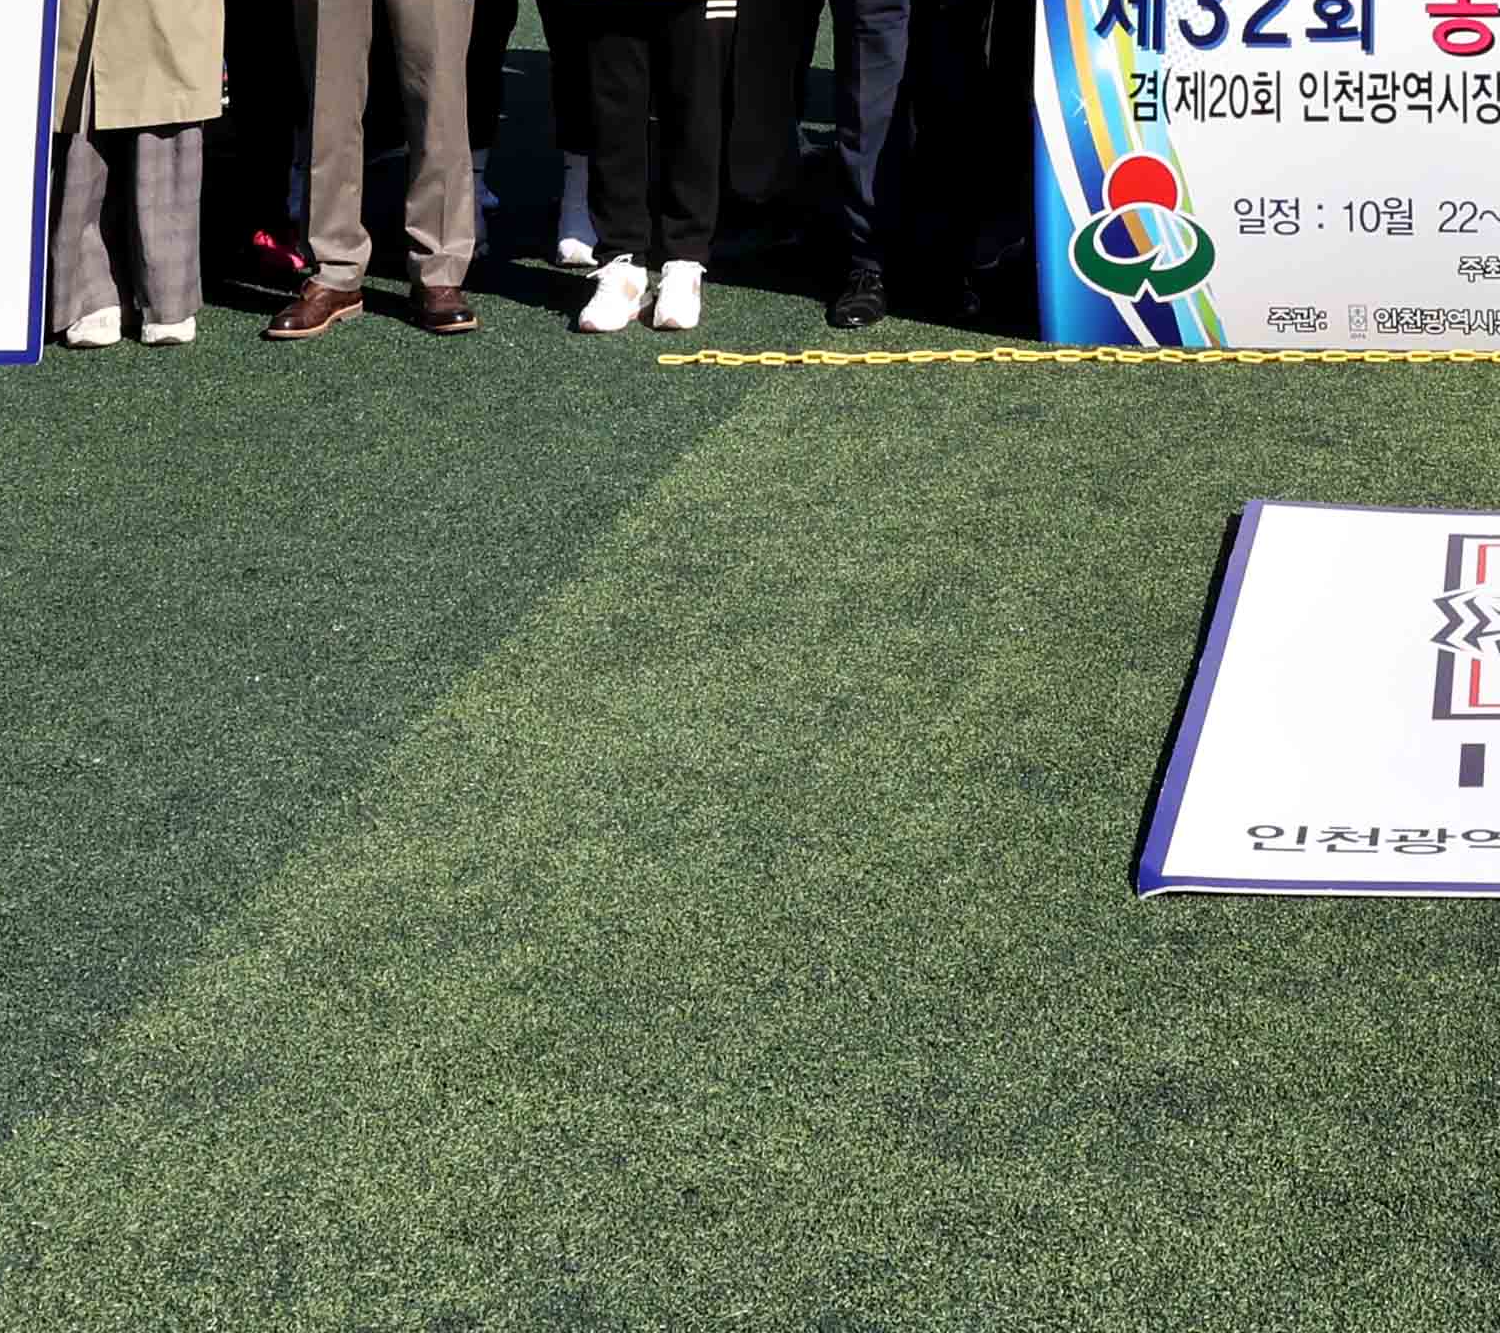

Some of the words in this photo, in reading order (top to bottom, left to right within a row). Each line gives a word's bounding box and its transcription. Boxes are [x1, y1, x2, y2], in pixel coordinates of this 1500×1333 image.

[1129, 70, 1282, 125] 겸(제20회
[1233, 196, 1300, 236] 일정
[1343, 196, 1414, 236] 10월
[1267, 306, 1328, 333] 주관:
